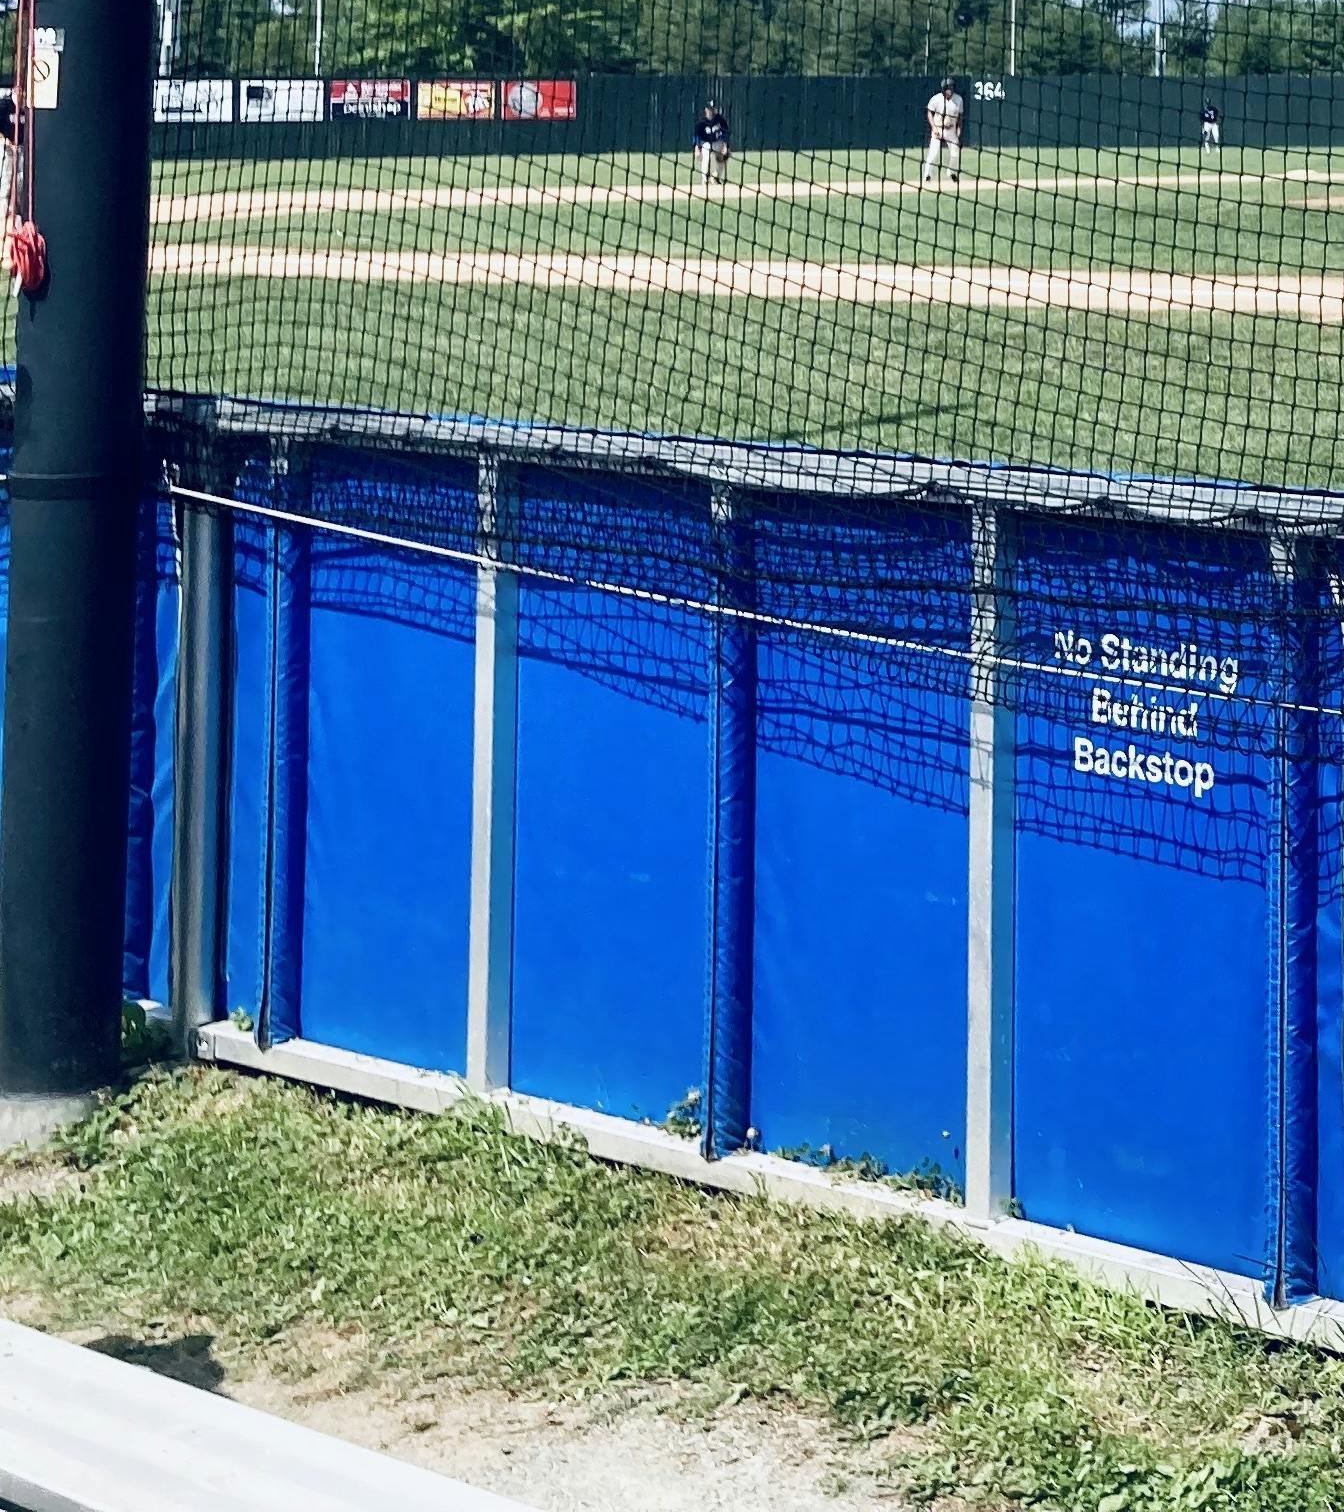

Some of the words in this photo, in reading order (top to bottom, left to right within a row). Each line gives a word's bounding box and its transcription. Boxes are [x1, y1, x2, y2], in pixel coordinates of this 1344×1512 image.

[974, 81, 1006, 101] 364
[1053, 630, 1093, 665] No
[1100, 633, 1239, 694] Standing
[1091, 687, 1199, 738] Behind
[1073, 736, 1215, 798] Backstop
